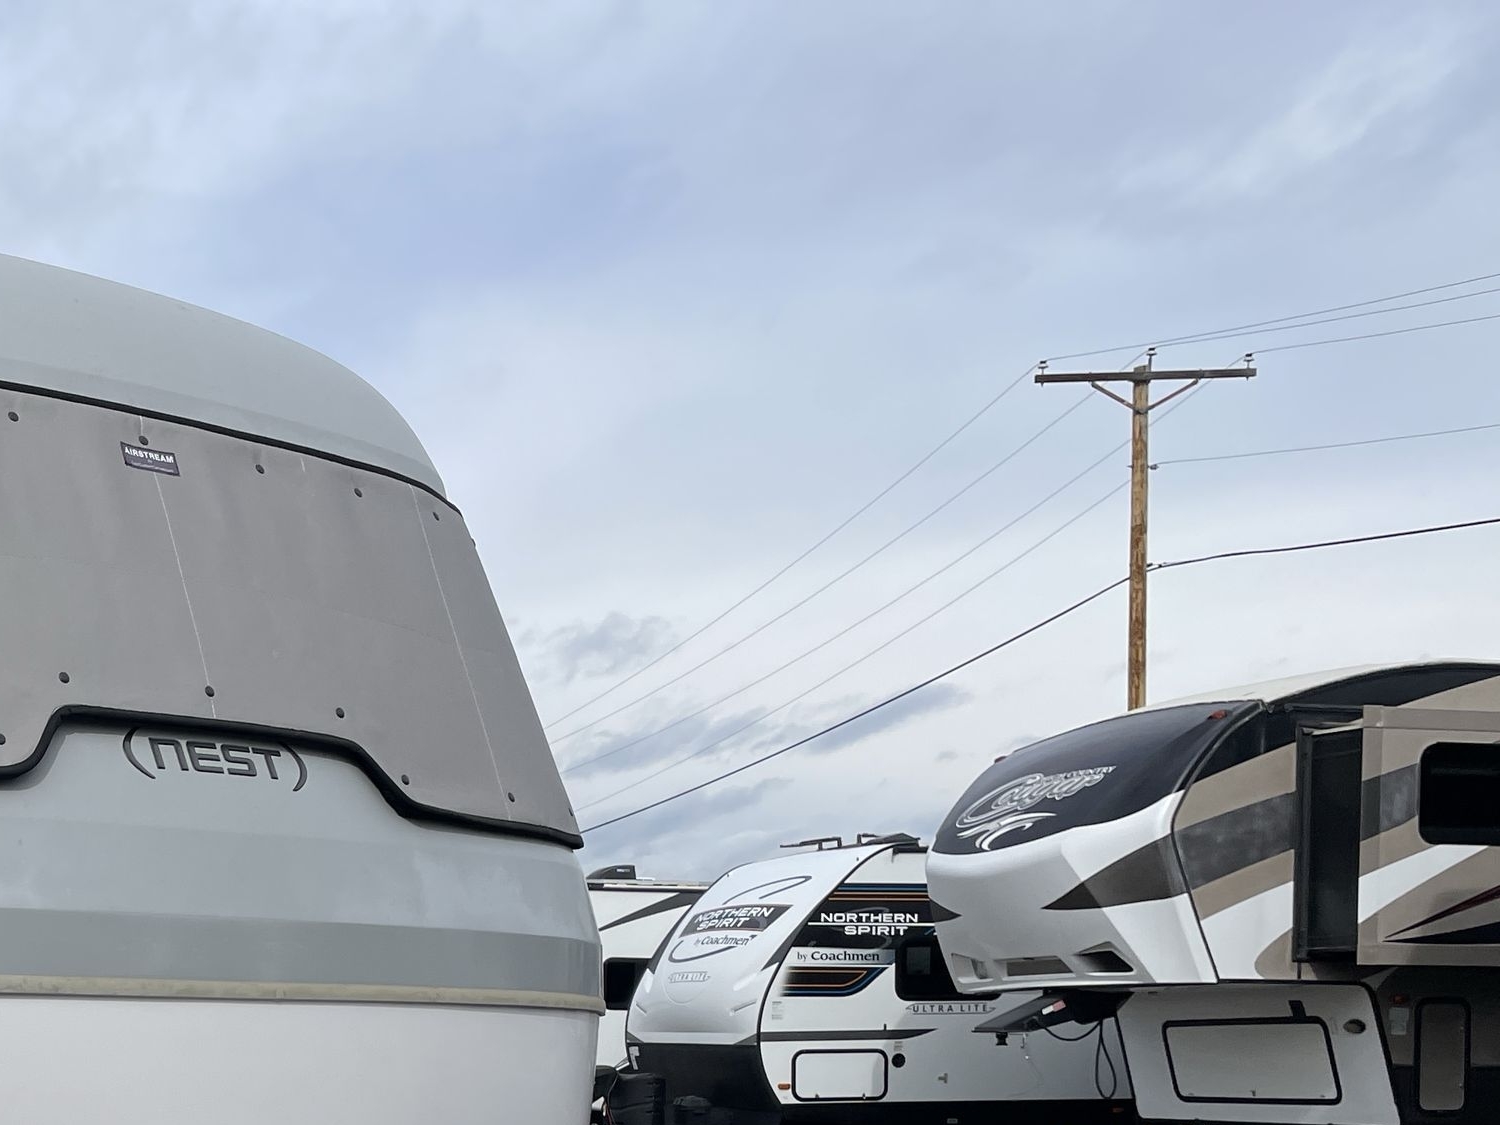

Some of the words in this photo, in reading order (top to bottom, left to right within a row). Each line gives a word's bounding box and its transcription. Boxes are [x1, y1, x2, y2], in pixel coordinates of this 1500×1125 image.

[125, 446, 174, 463] AIRSTREAM
[694, 907, 775, 923] NORTHERN
[820, 913, 918, 923] NORTHERN
[697, 917, 750, 931] SPIRIT
[844, 926, 908, 936] SPIRIT
[701, 934, 749, 946] Coachmen
[797, 951, 808, 961] by
[811, 951, 880, 961] Coachmen
[912, 1004, 954, 1013] ULTRA
[960, 1004, 987, 1012] LITE
